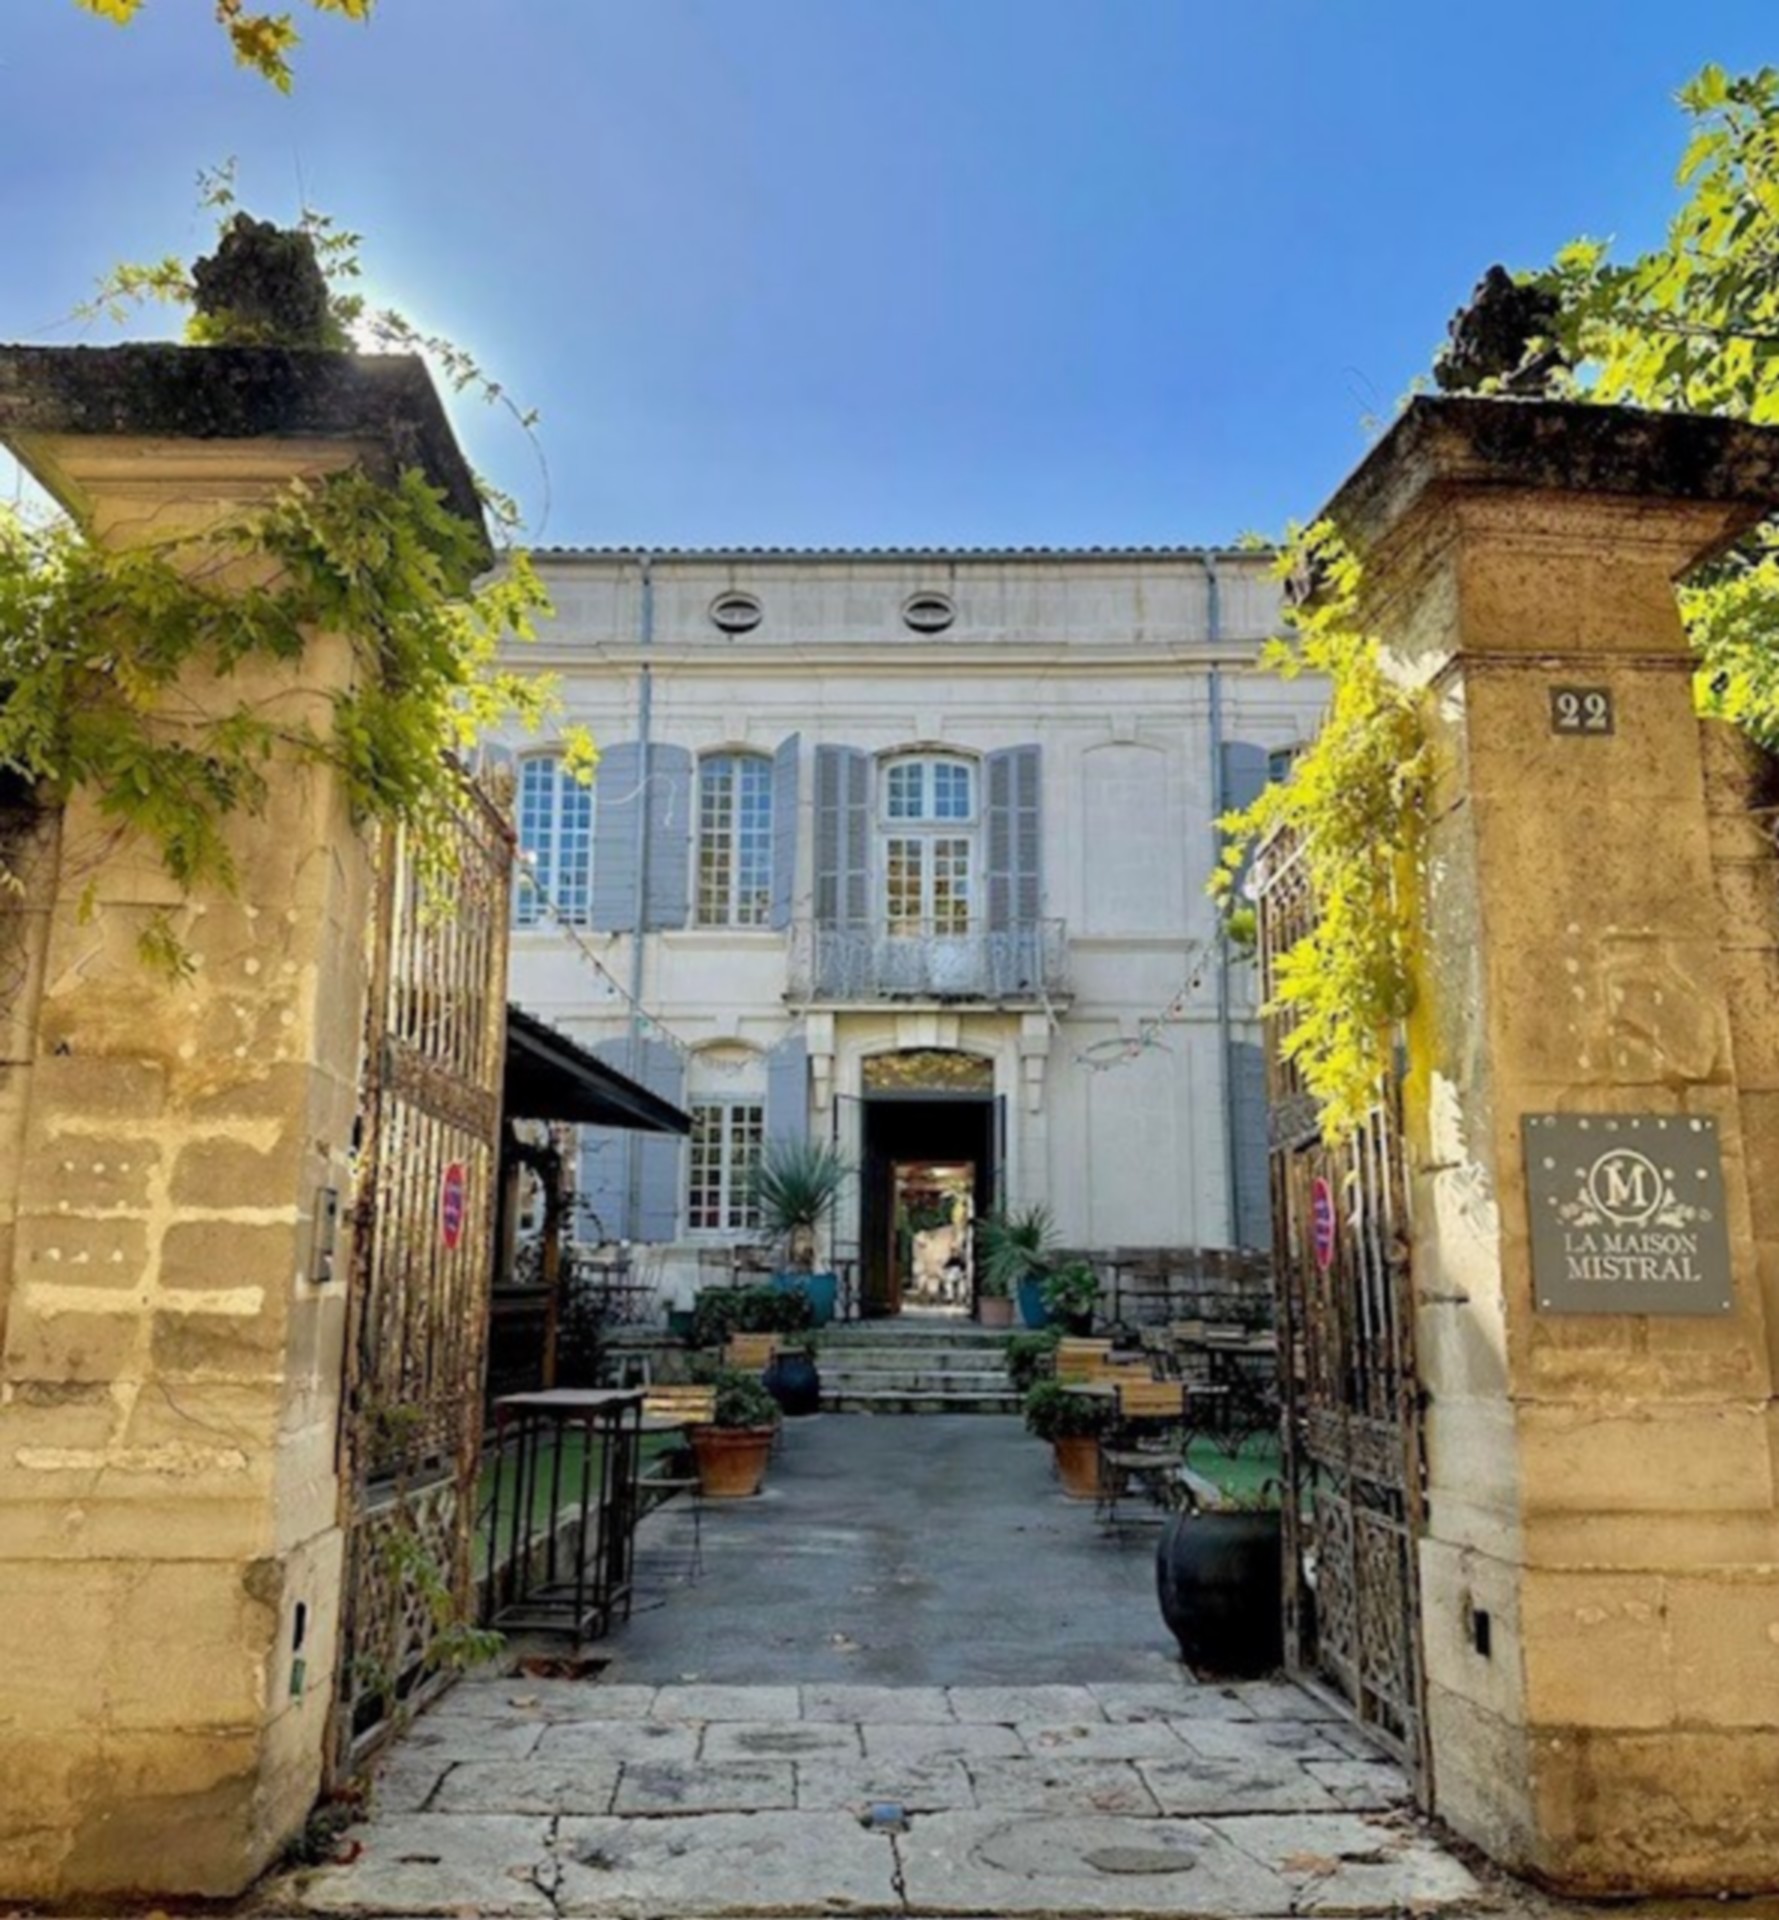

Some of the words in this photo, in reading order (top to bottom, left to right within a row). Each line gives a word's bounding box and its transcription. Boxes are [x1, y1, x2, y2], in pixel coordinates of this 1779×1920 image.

[1557, 692, 1607, 729] 22
[1603, 1164, 1648, 1208] M
[1565, 1233, 1597, 1253] LA
[1602, 1233, 1698, 1255] MAISON
[1566, 1256, 1701, 1281] MISTRAL
